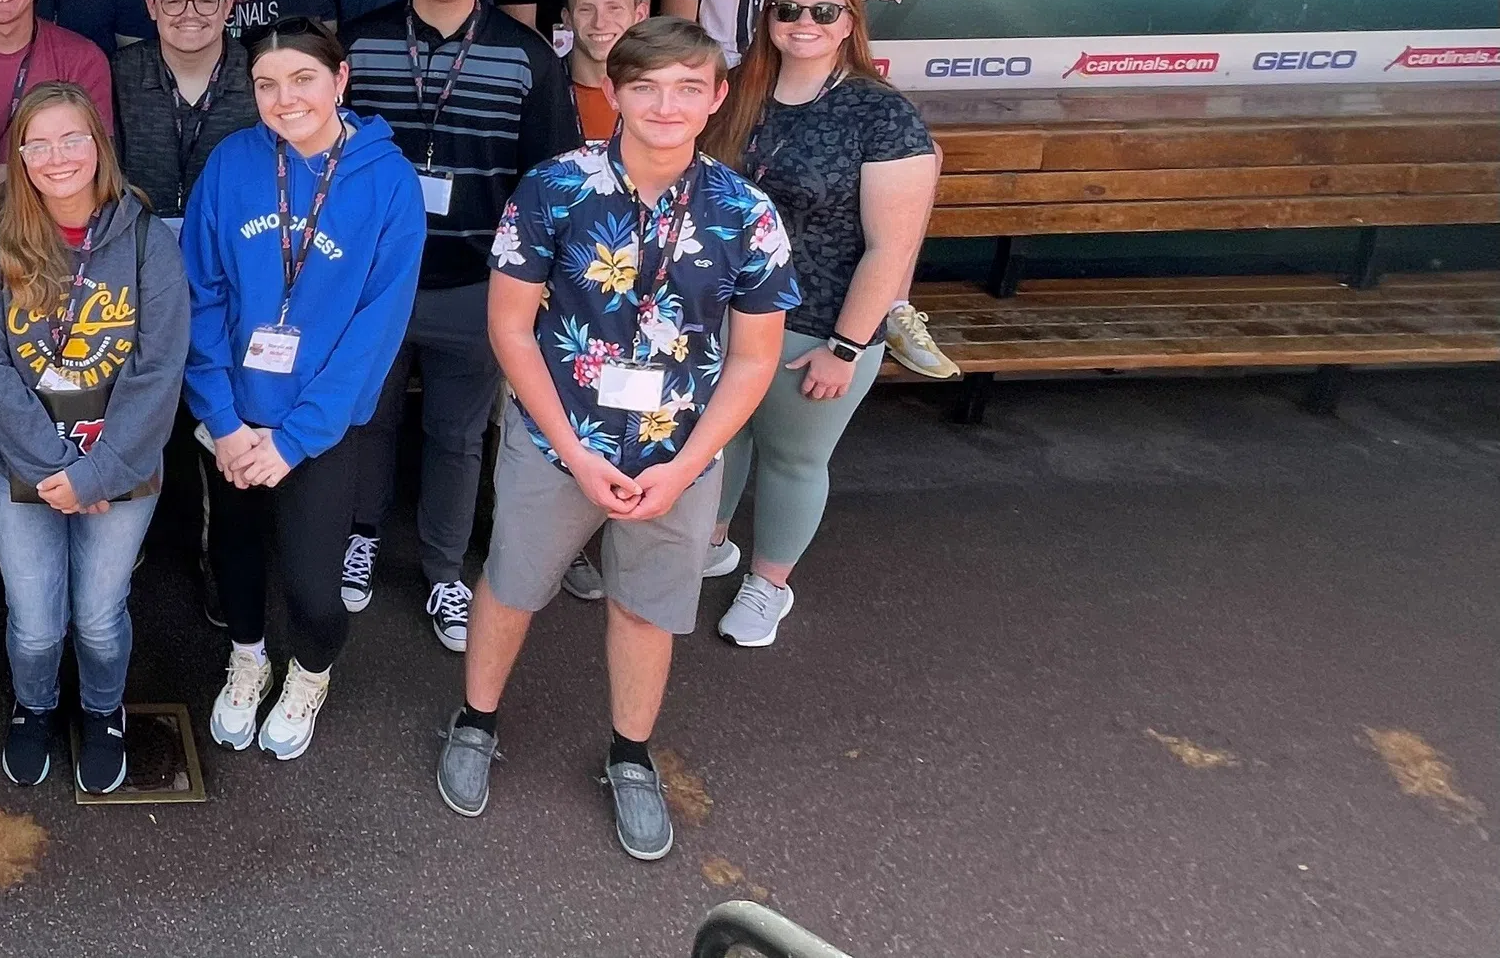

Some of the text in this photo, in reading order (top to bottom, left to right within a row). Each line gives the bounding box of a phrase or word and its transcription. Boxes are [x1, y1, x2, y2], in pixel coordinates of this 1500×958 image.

[924, 55, 1032, 78] GEICO
[1085, 55, 1215, 74] cardinals.com
[1252, 50, 1358, 71] GEICO
[240, 213, 343, 260] WHO CAES?
[71, 286, 136, 336] Cob
